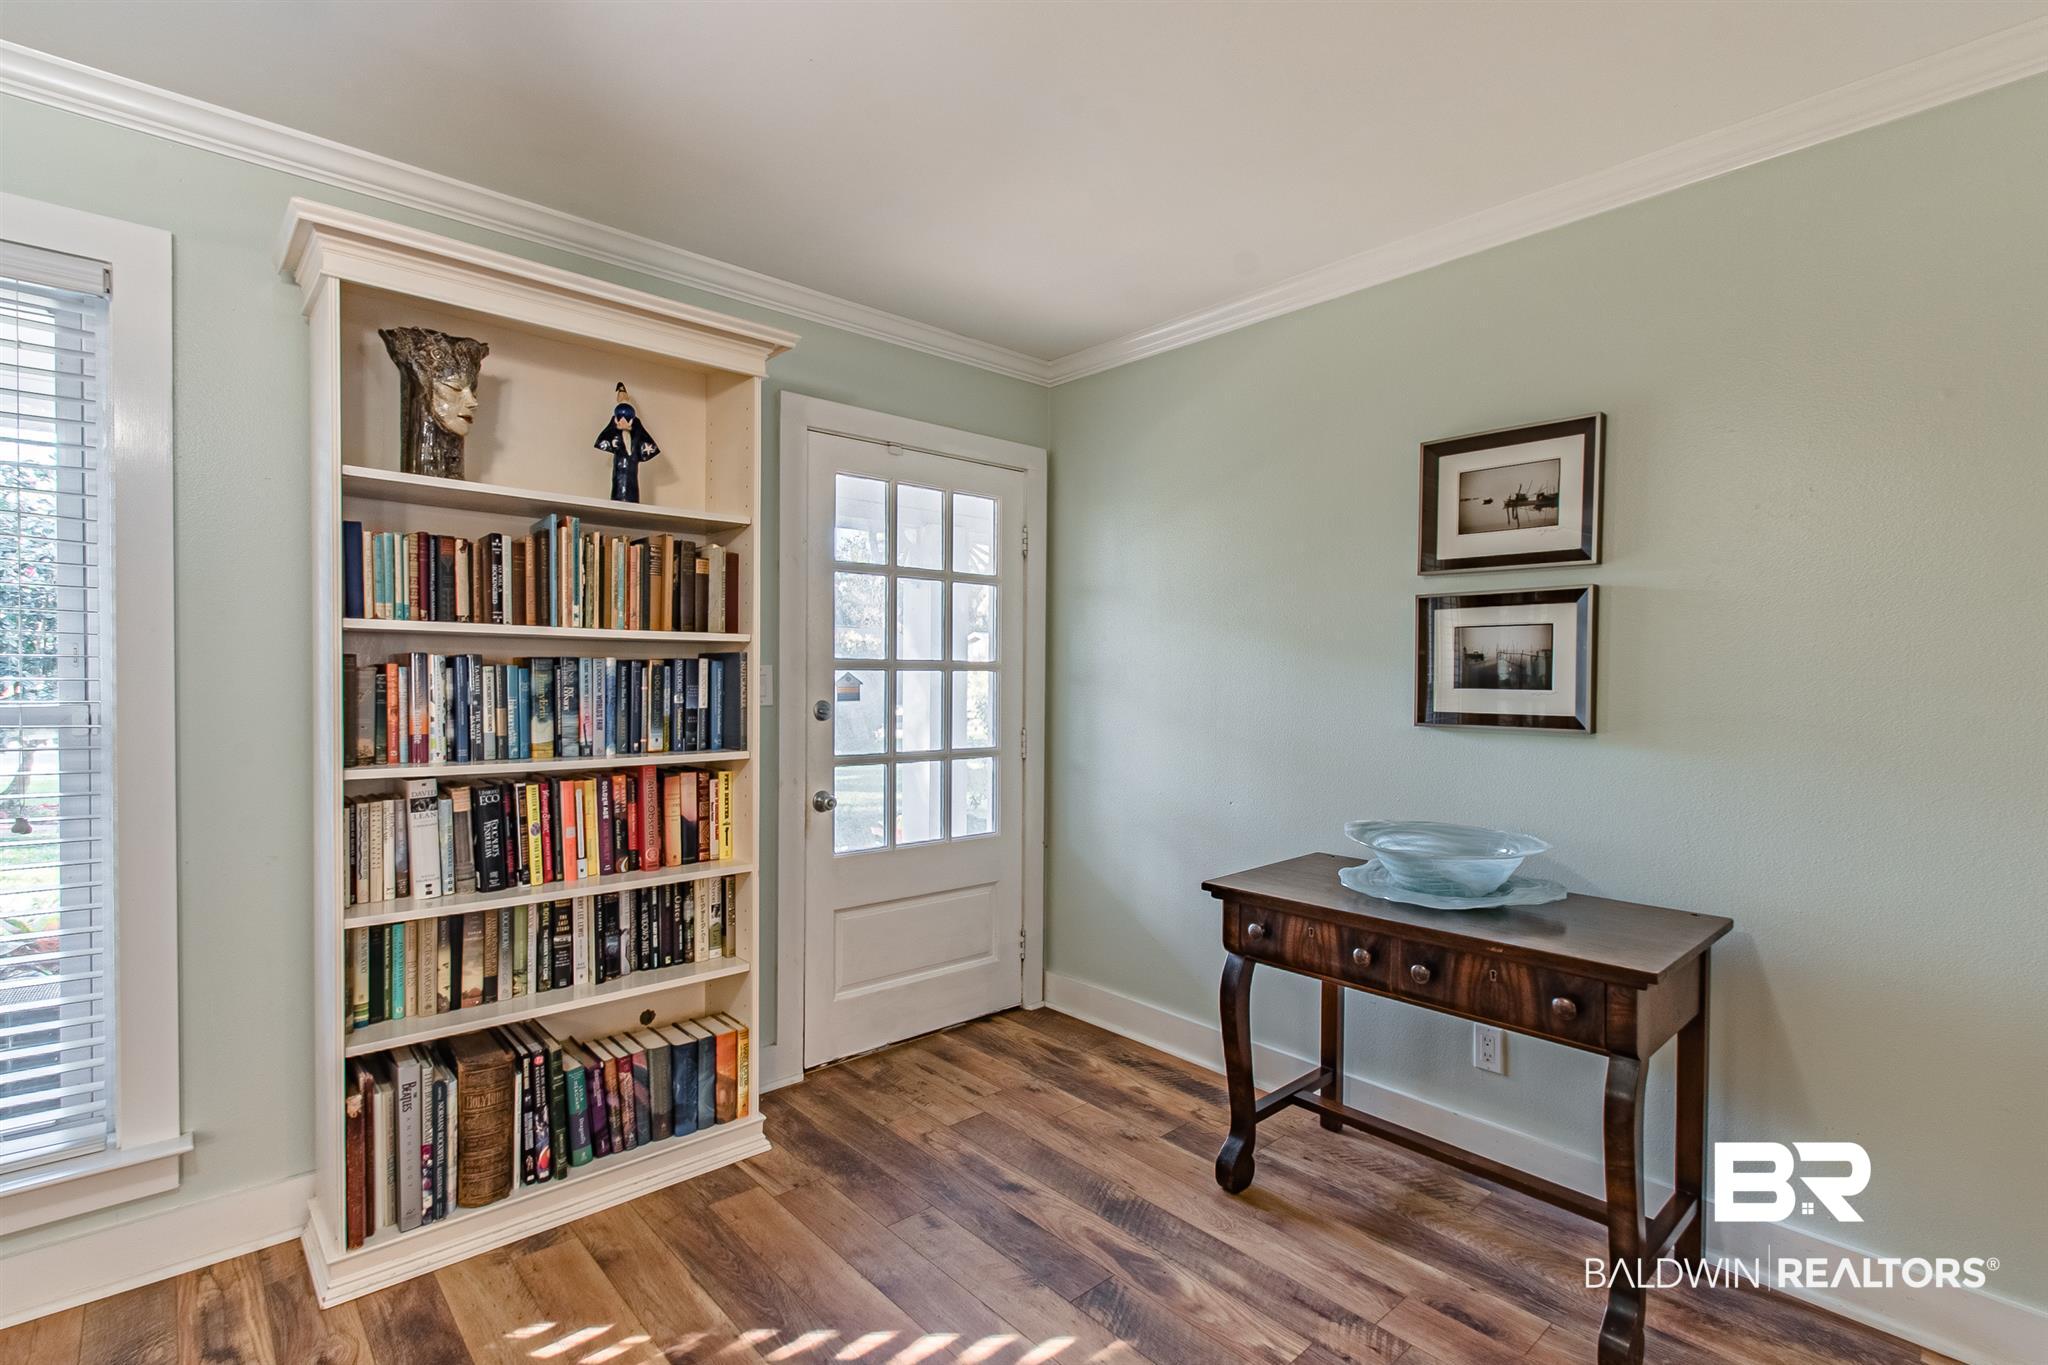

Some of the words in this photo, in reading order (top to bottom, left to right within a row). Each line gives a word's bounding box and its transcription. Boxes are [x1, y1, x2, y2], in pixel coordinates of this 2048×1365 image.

[411, 789, 437, 798] DAVID
[480, 794, 500, 806] ECO
[647, 780, 656, 804] Atlas
[413, 812, 437, 821] LEAN
[647, 805, 657, 846] Obscura
[577, 921, 585, 938] LEWIS
[400, 1081, 417, 1112] BEATLES
[465, 1093, 487, 1109] HOLY
[437, 1101, 445, 1131] NORMAN
[436, 1132, 444, 1166] ROCKWELL
